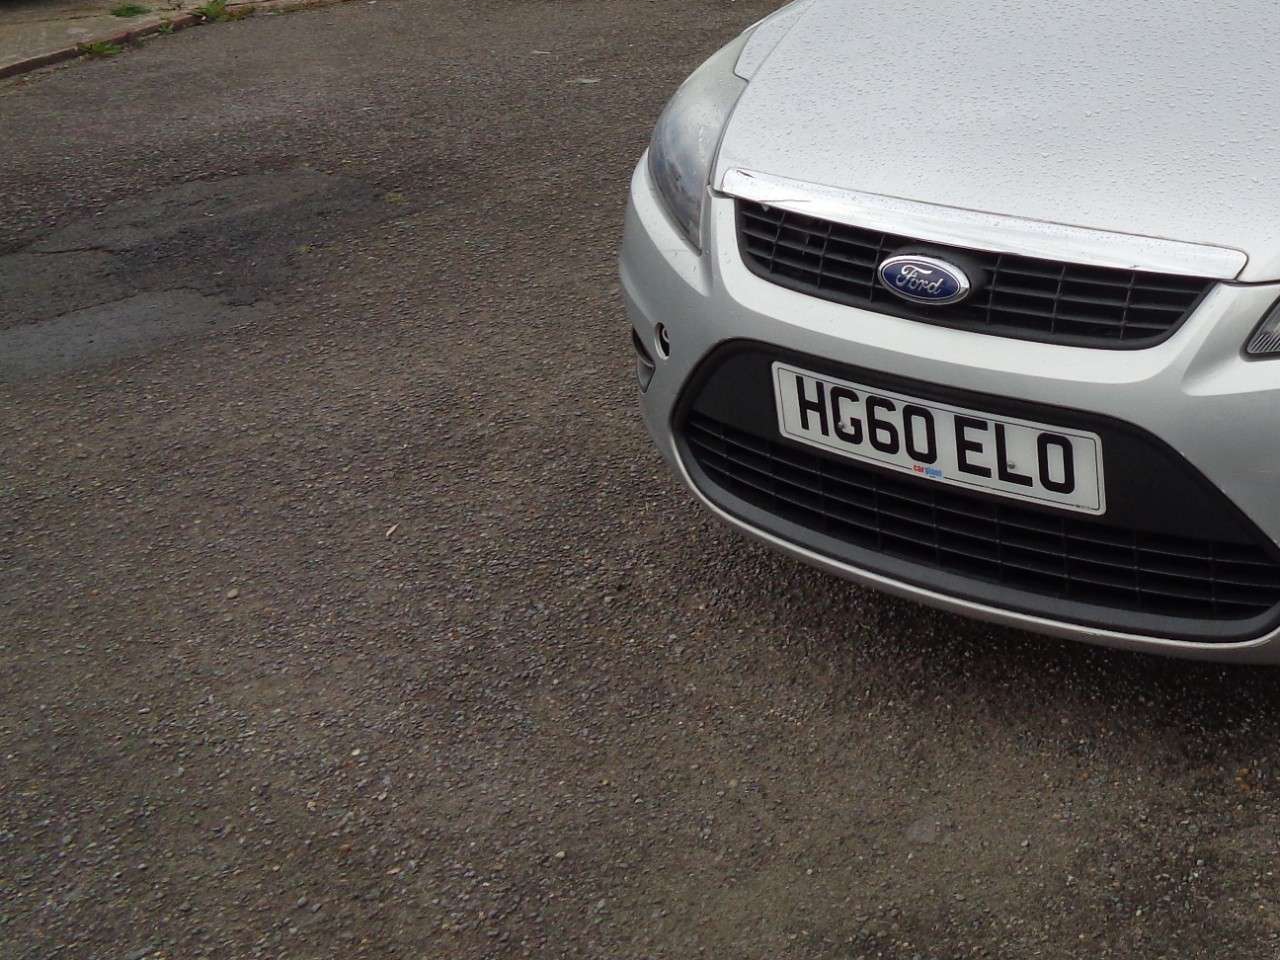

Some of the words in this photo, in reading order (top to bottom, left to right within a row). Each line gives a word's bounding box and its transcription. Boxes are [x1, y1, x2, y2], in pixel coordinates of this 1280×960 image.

[896, 265, 943, 294] Ford
[795, 375, 937, 465] HG60
[953, 414, 1075, 494] ELO
